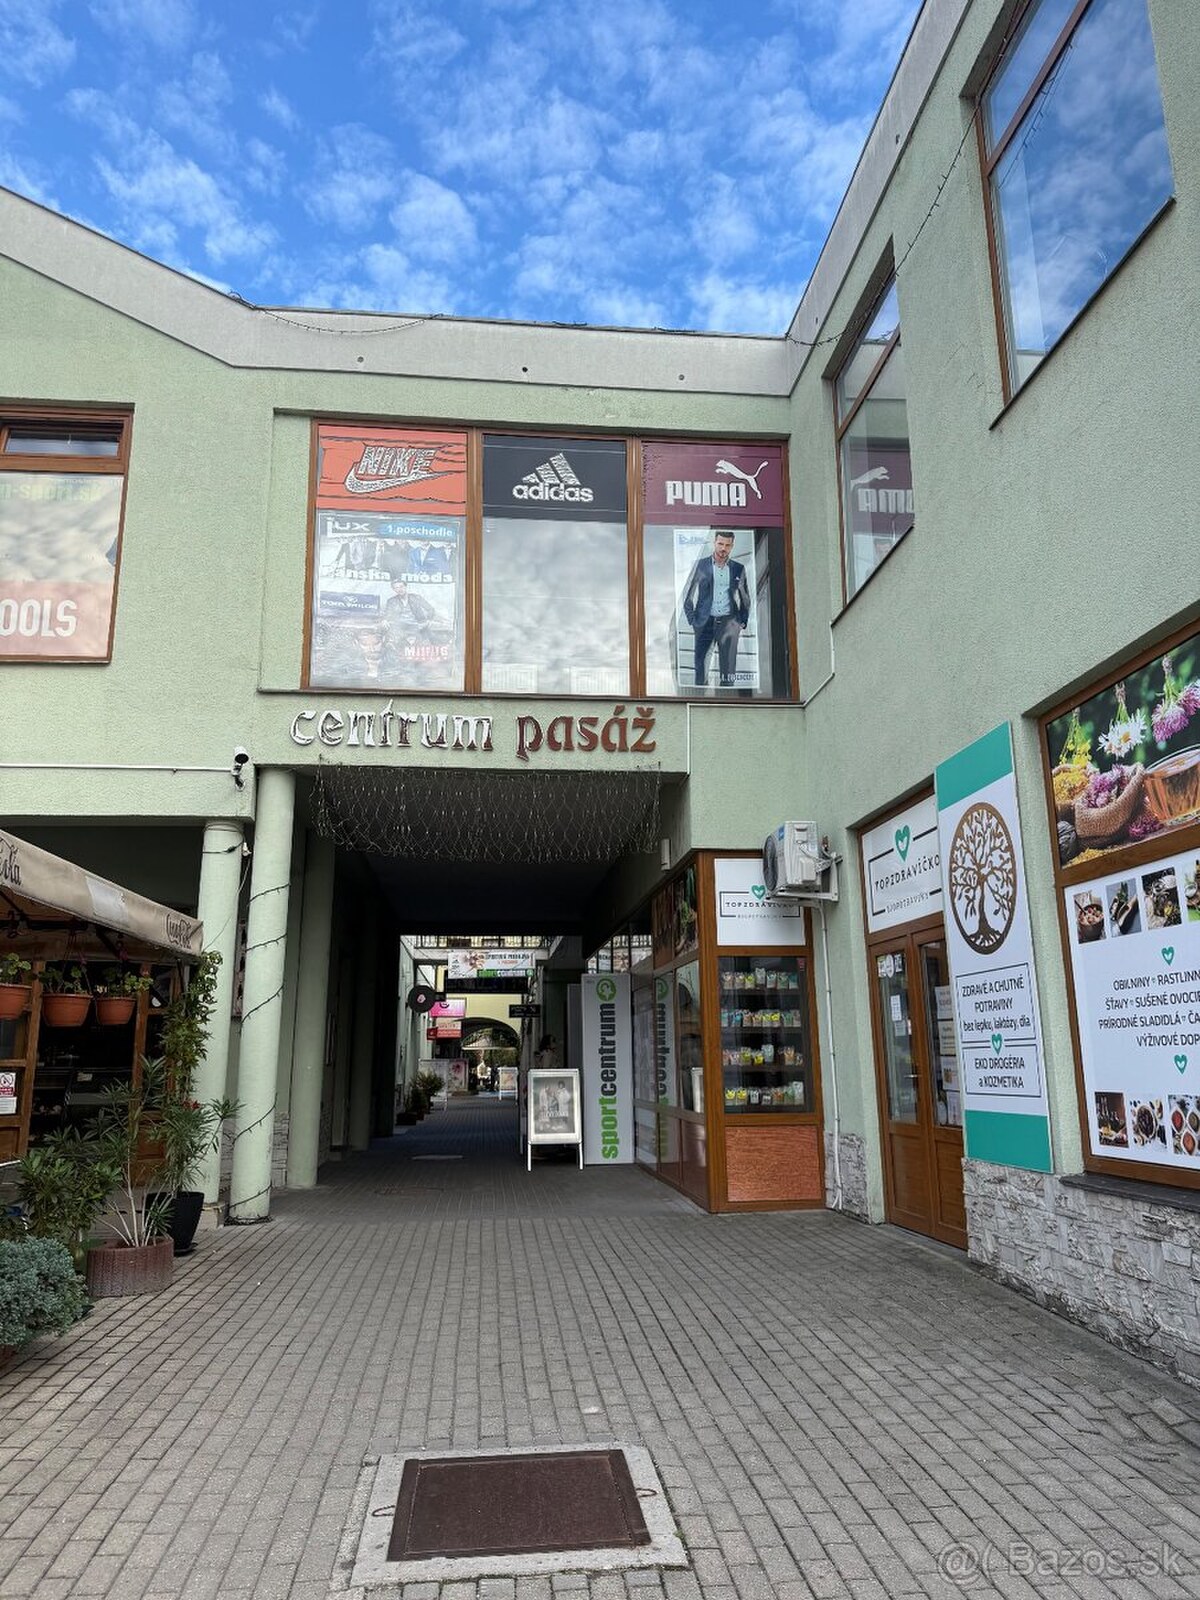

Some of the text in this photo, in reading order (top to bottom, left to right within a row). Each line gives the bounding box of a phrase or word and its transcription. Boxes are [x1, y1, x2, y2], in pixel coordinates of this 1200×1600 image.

[358, 446, 436, 477] NIKE
[512, 483, 594, 502] adidas
[666, 480, 746, 507] PUMA
[290, 700, 656, 761] centrum pasáž
[962, 980, 988, 997] ZDRAVÉ
[995, 974, 1024, 993] CHUTNÉ
[1113, 976, 1150, 991] OBILNINY
[975, 998, 1013, 1013] POTRAVINY
[1136, 992, 1168, 1008] SUŠENÉ
[1140, 1011, 1181, 1027] SLADIDLÁ
[598, 1003, 620, 1160] sportcentrum
[984, 1076, 1024, 1088] KOZMETIKA
